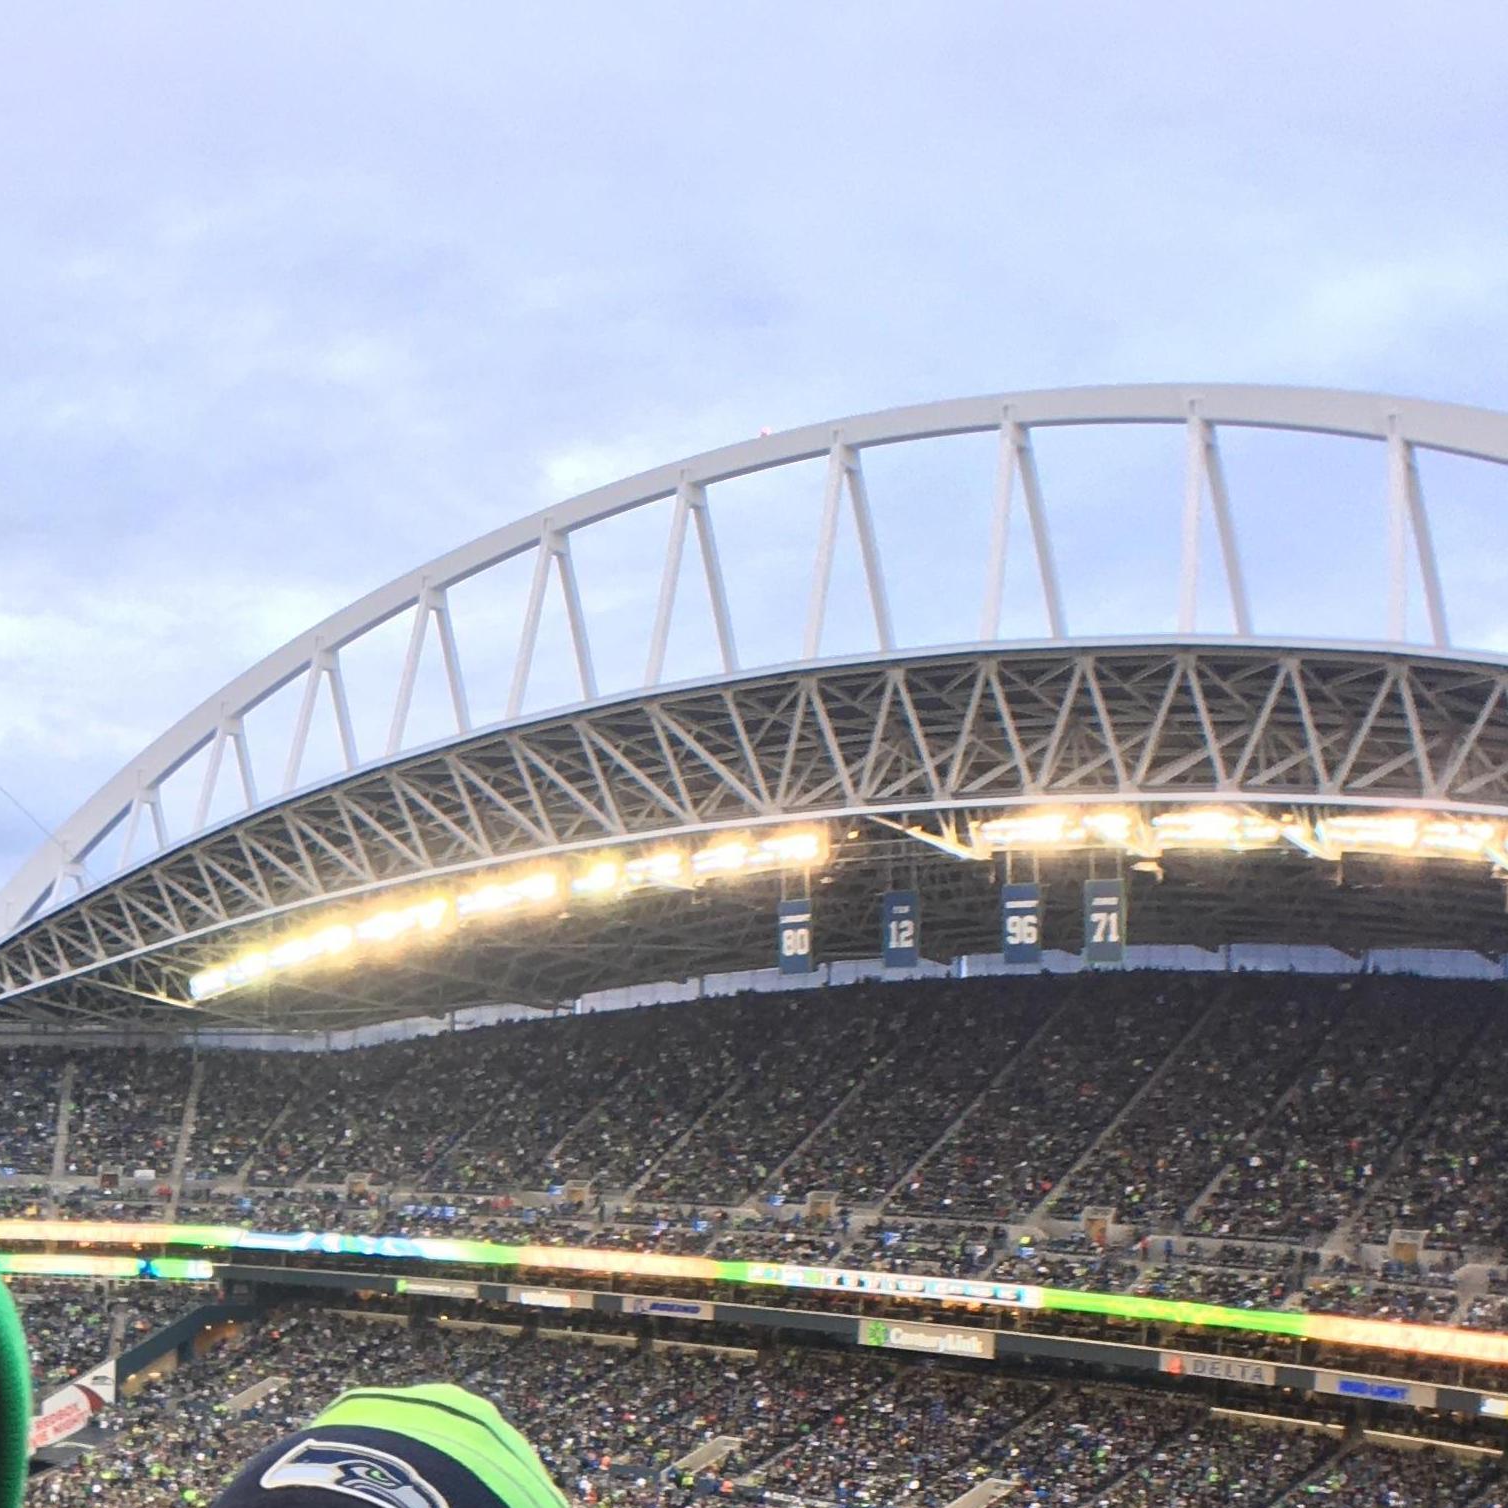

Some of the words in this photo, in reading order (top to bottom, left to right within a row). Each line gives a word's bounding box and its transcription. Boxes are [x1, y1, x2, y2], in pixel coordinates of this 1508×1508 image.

[889, 919, 915, 949] 12
[1006, 914, 1038, 945] 96
[1090, 911, 1120, 943] 71
[782, 928, 811, 957] 80
[1192, 1359, 1265, 1382] DELTA
